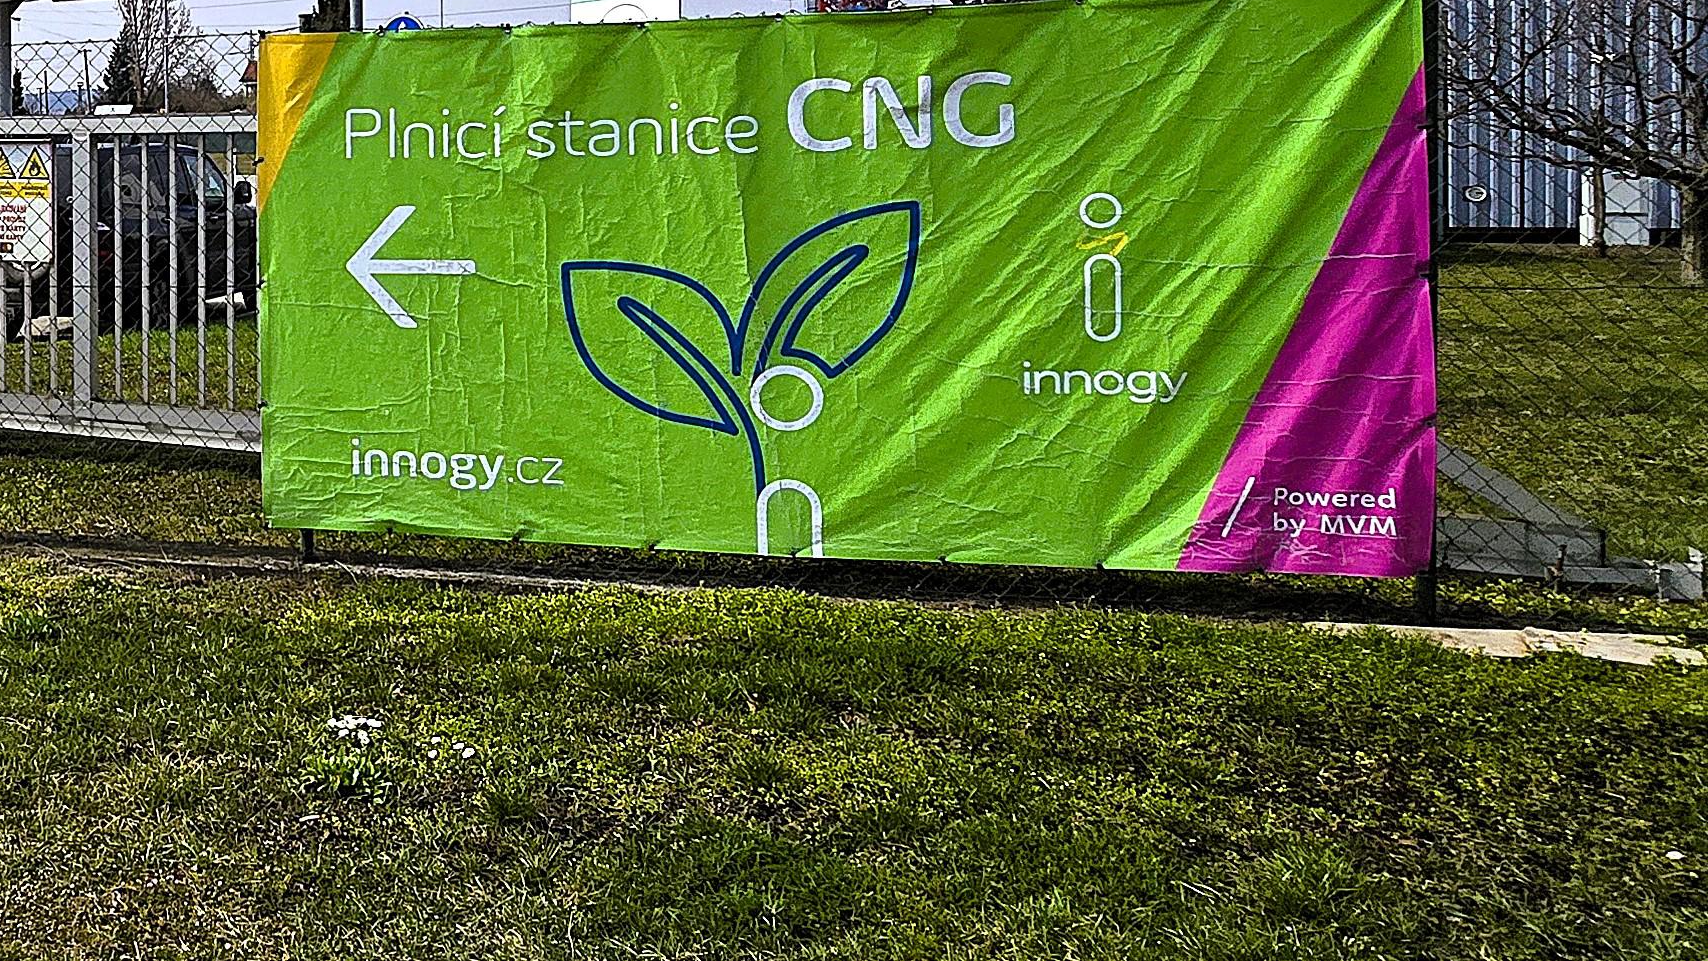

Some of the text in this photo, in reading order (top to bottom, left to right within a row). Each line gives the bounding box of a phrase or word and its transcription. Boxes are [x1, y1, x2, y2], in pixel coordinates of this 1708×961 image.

[344, 71, 1017, 160] Plnicí stanice CNG
[1022, 360, 1188, 403] innogy
[350, 437, 565, 491] innogy.cz
[1273, 487, 1397, 509] Powered
[1273, 511, 1397, 538] by MVM
